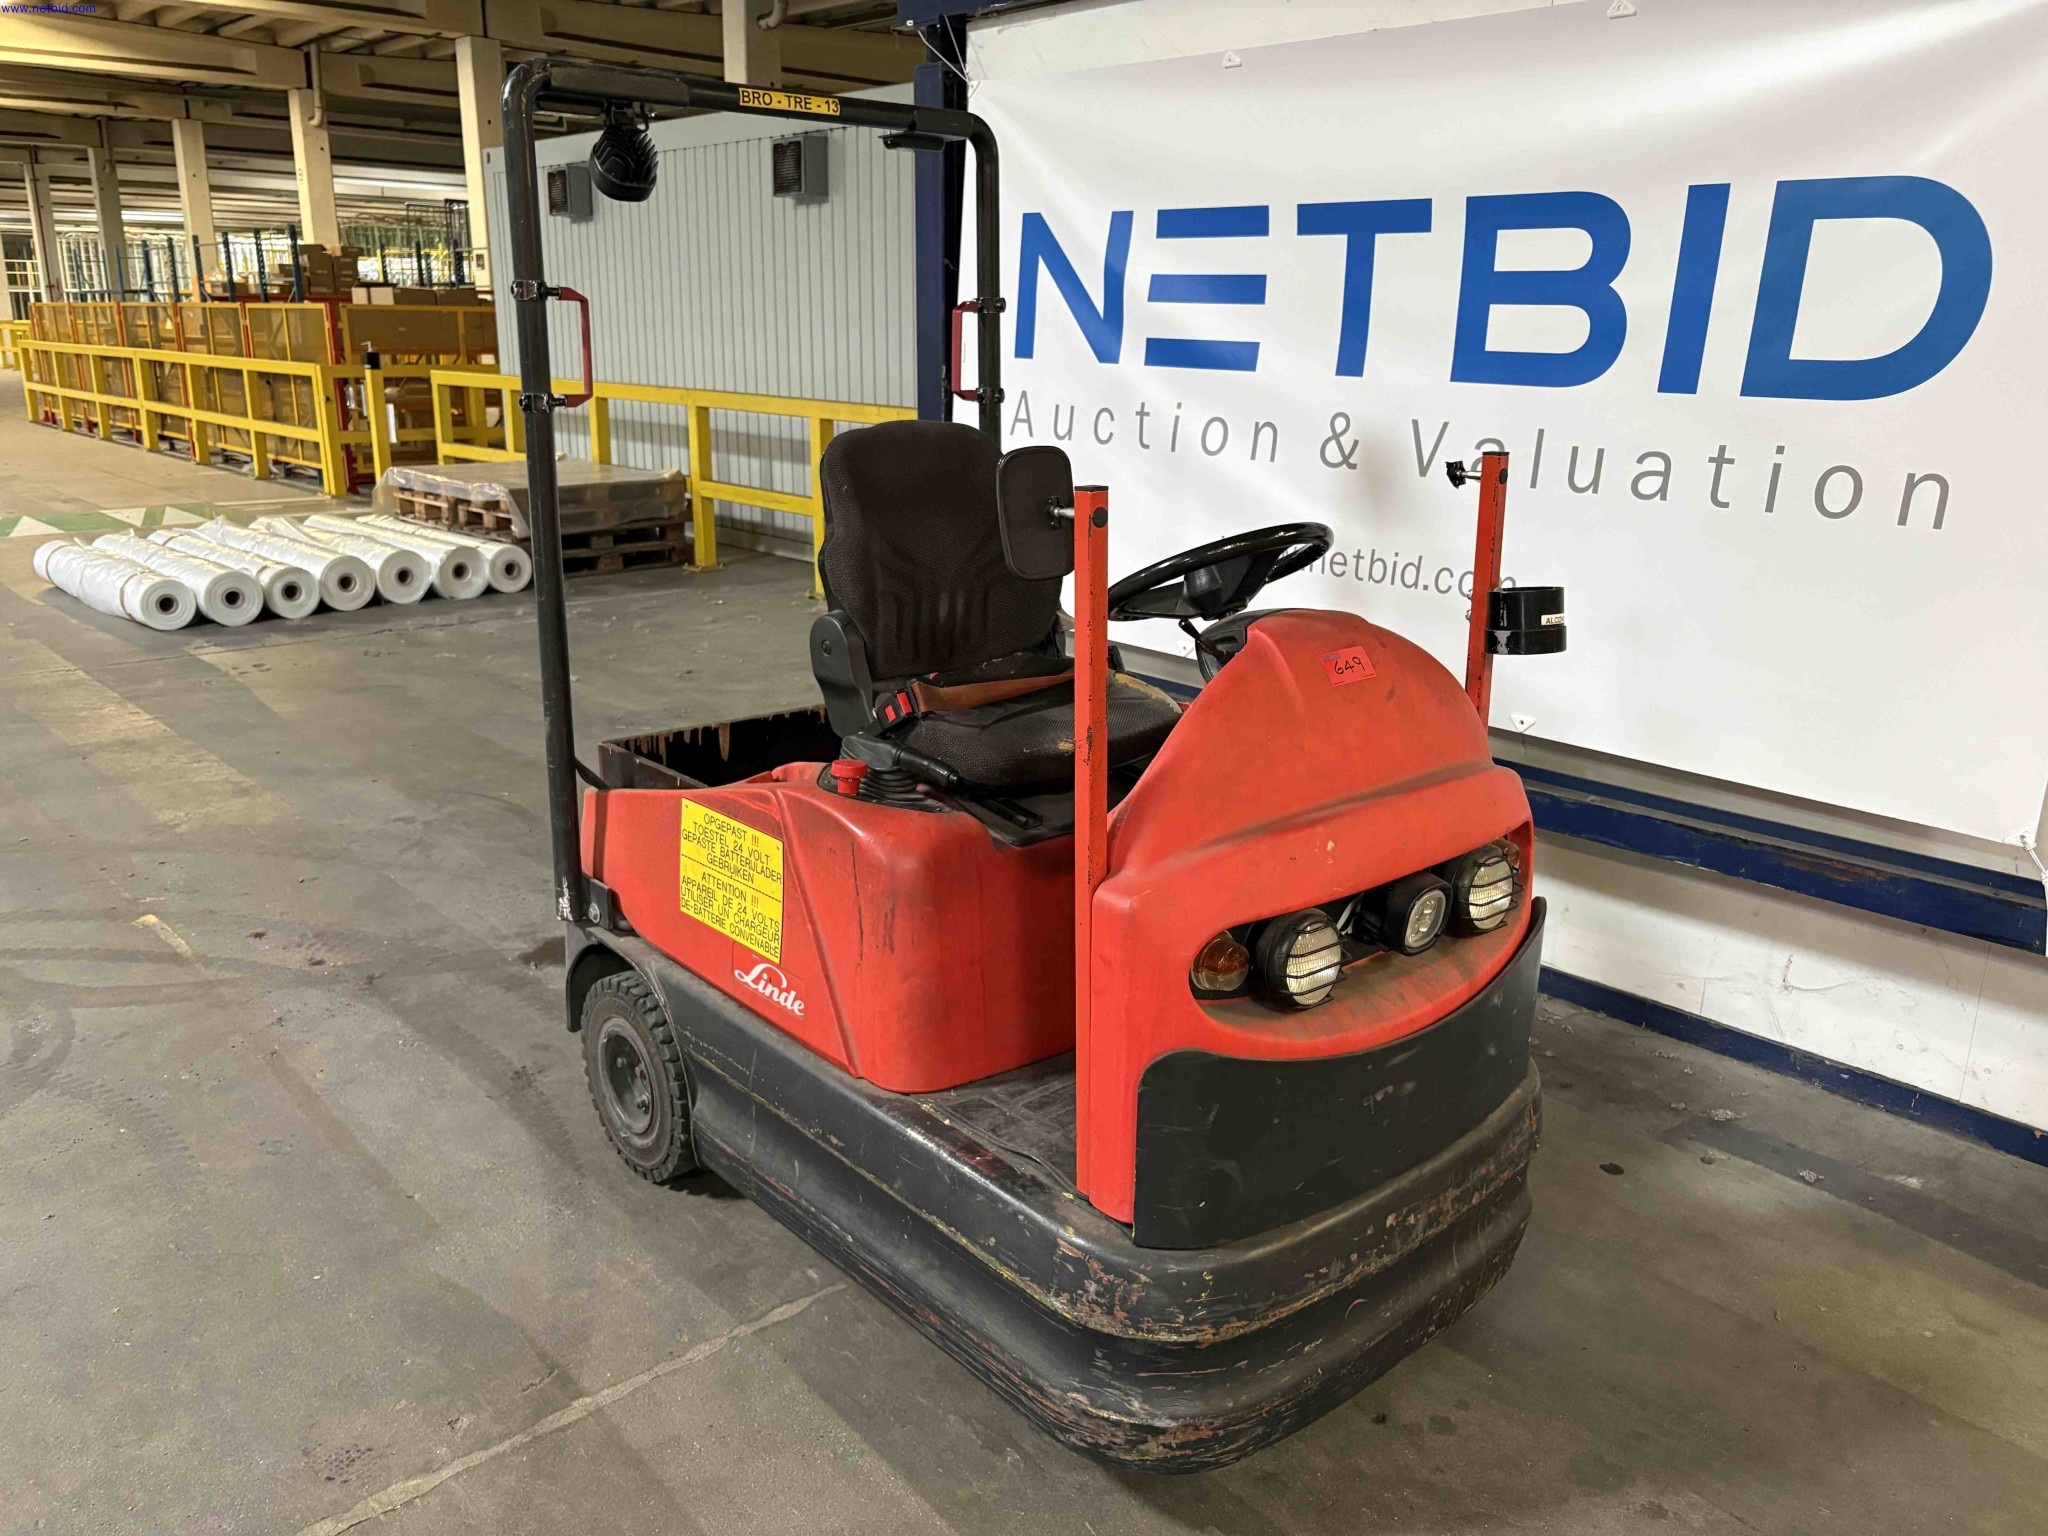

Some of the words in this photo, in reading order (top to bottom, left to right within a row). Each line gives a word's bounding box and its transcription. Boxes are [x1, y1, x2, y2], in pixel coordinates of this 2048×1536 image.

[741, 90, 773, 106] BRO
[785, 95, 812, 110] TRE
[824, 100, 839, 113] 13
[1013, 175, 1993, 400] NETBID
[1009, 390, 1278, 463] Auction
[1319, 411, 1360, 470] &
[1334, 656, 1366, 675] 649
[693, 821, 729, 848] TOESTEL
[733, 840, 743, 854] 24
[748, 846, 771, 866] VOLT
[704, 813, 748, 842] OPGEPAST
[681, 828, 716, 854] GEPASTE
[719, 846, 782, 885] BATTERIJLADER
[706, 852, 755, 884] GEBRUIKEN
[681, 874, 718, 902] APPAREIL
[722, 895, 734, 909] DE
[737, 902, 748, 916] 24
[751, 909, 780, 933] VOLTS
[701, 871, 747, 903] ATTENTION
[680, 885, 714, 911] UTILISER
[717, 904, 730, 919] UN
[733, 912, 780, 946] CHARGEUR
[729, 922, 780, 959] CONVENABLE
[734, 963, 805, 1016] Linde
